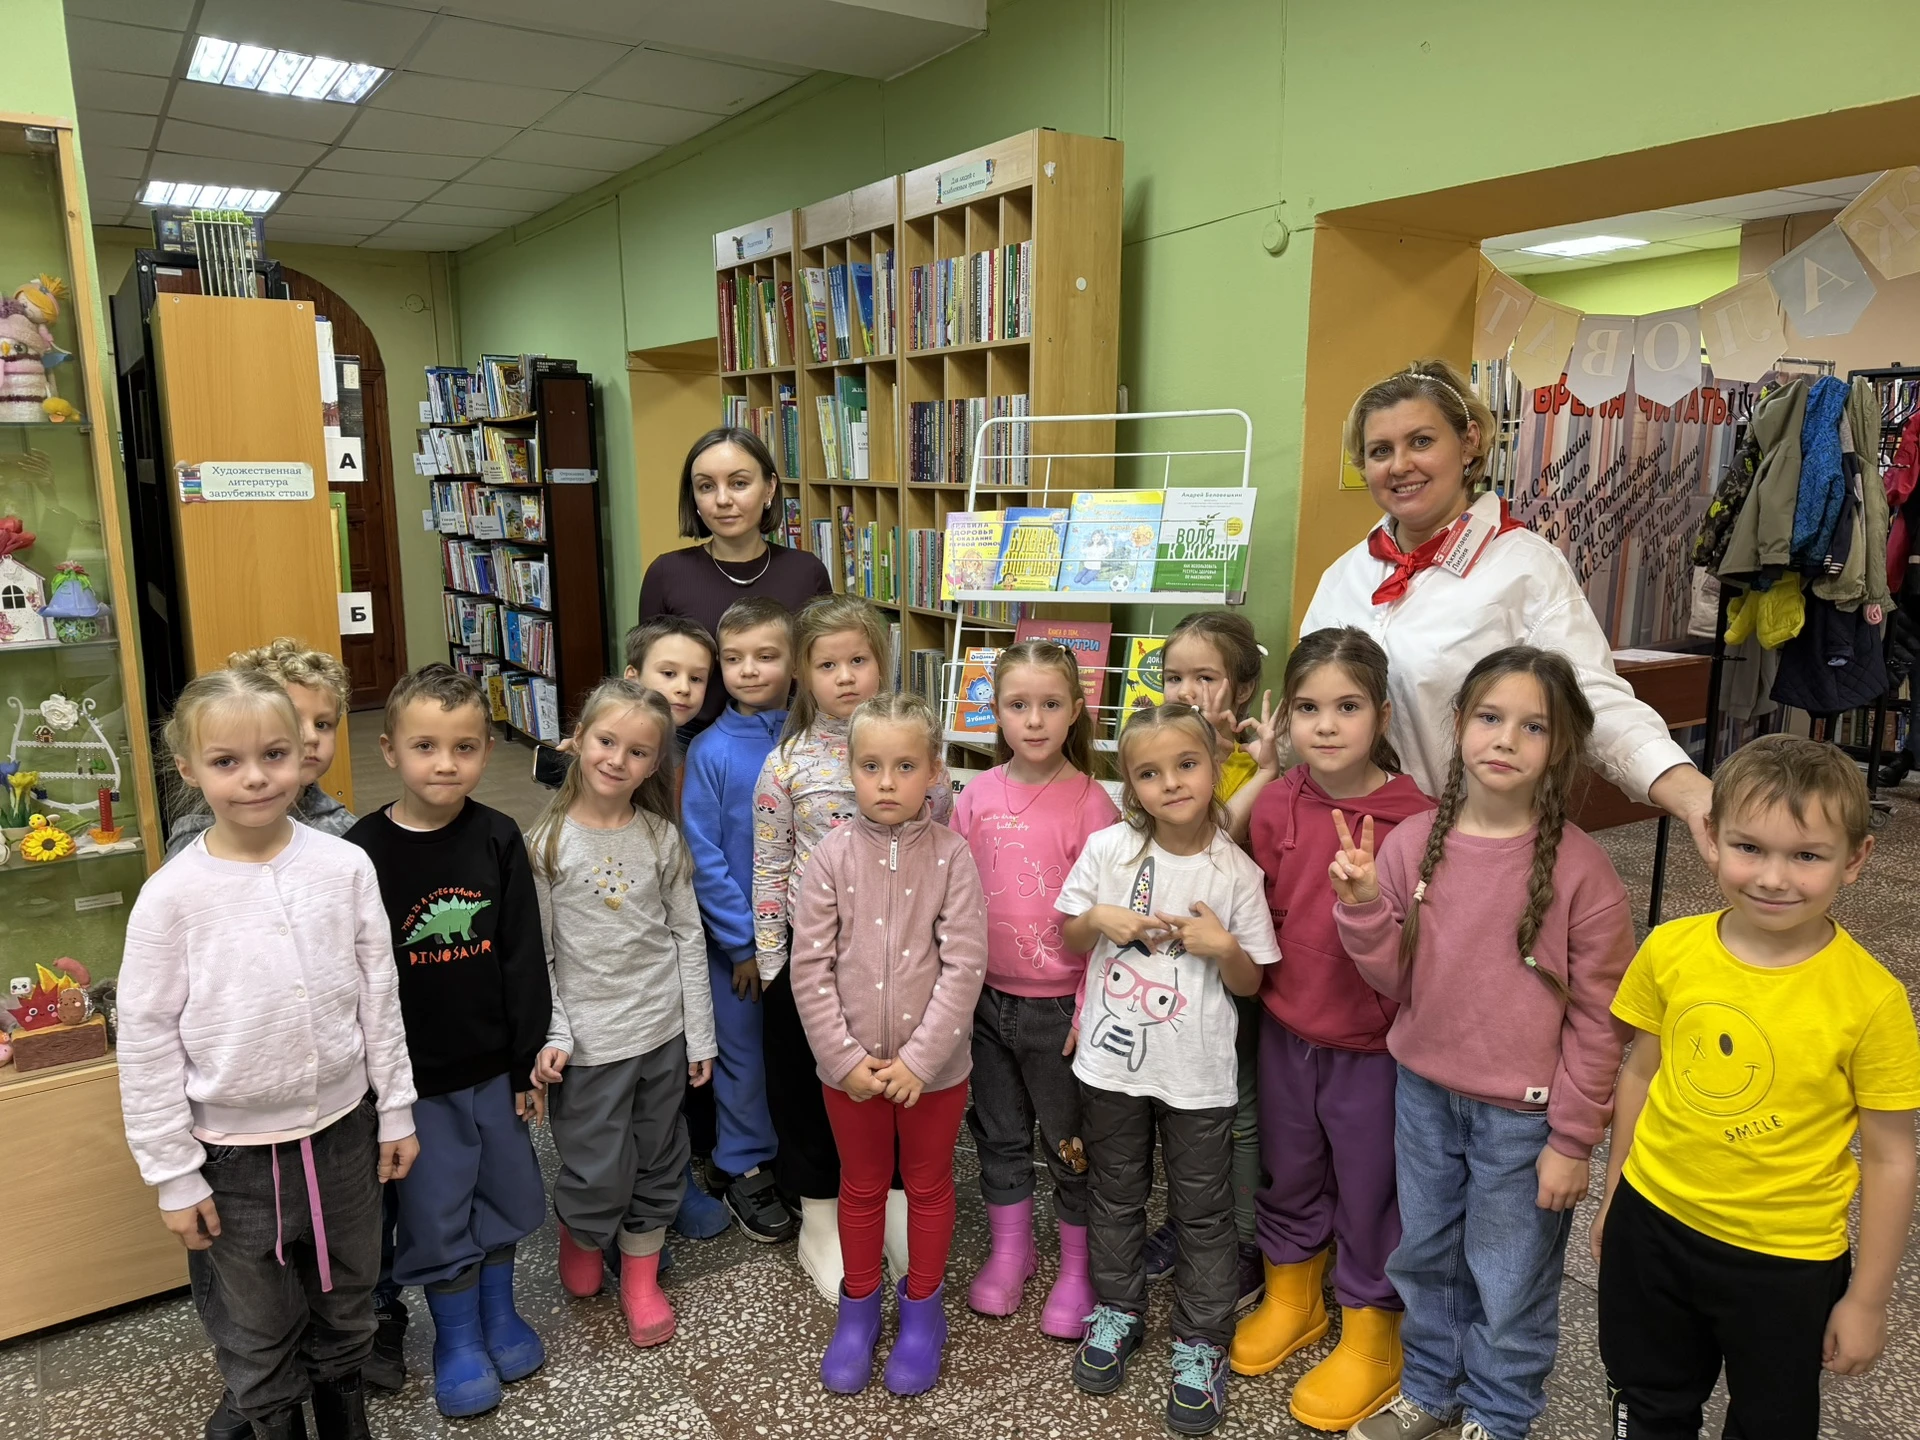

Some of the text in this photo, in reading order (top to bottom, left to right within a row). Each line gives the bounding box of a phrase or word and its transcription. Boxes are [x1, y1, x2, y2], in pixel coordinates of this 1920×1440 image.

[339, 452, 357, 470] А
[1541, 430, 1591, 484] Пушкин
[212, 466, 302, 476] Художественная
[1594, 437, 1668, 516] Достоевский
[208, 489, 276, 498] зарубежных
[228, 480, 288, 488] литература
[1550, 462, 1590, 510] Гоголь
[1657, 467, 1701, 522] Толстой
[1598, 464, 1663, 540] Островский
[1660, 496, 1691, 537] Чехов
[1010, 528, 1060, 552] БУКВАРЬ
[1176, 528, 1215, 544] ВОЛЯ
[1002, 552, 1060, 576] ЗДОРОВЬЯ
[1167, 544, 1240, 561] К ЖИЗНИ
[1452, 548, 1469, 570] Лилия
[350, 606, 367, 622] Б
[401, 914, 415, 932] THIS
[412, 904, 421, 914] IS
[428, 887, 482, 900] STEGOSAURUS
[409, 940, 492, 966] DINOSAUR
[1724, 1114, 1783, 1142] SMILE
[1617, 1420, 1627, 1438] CITY
